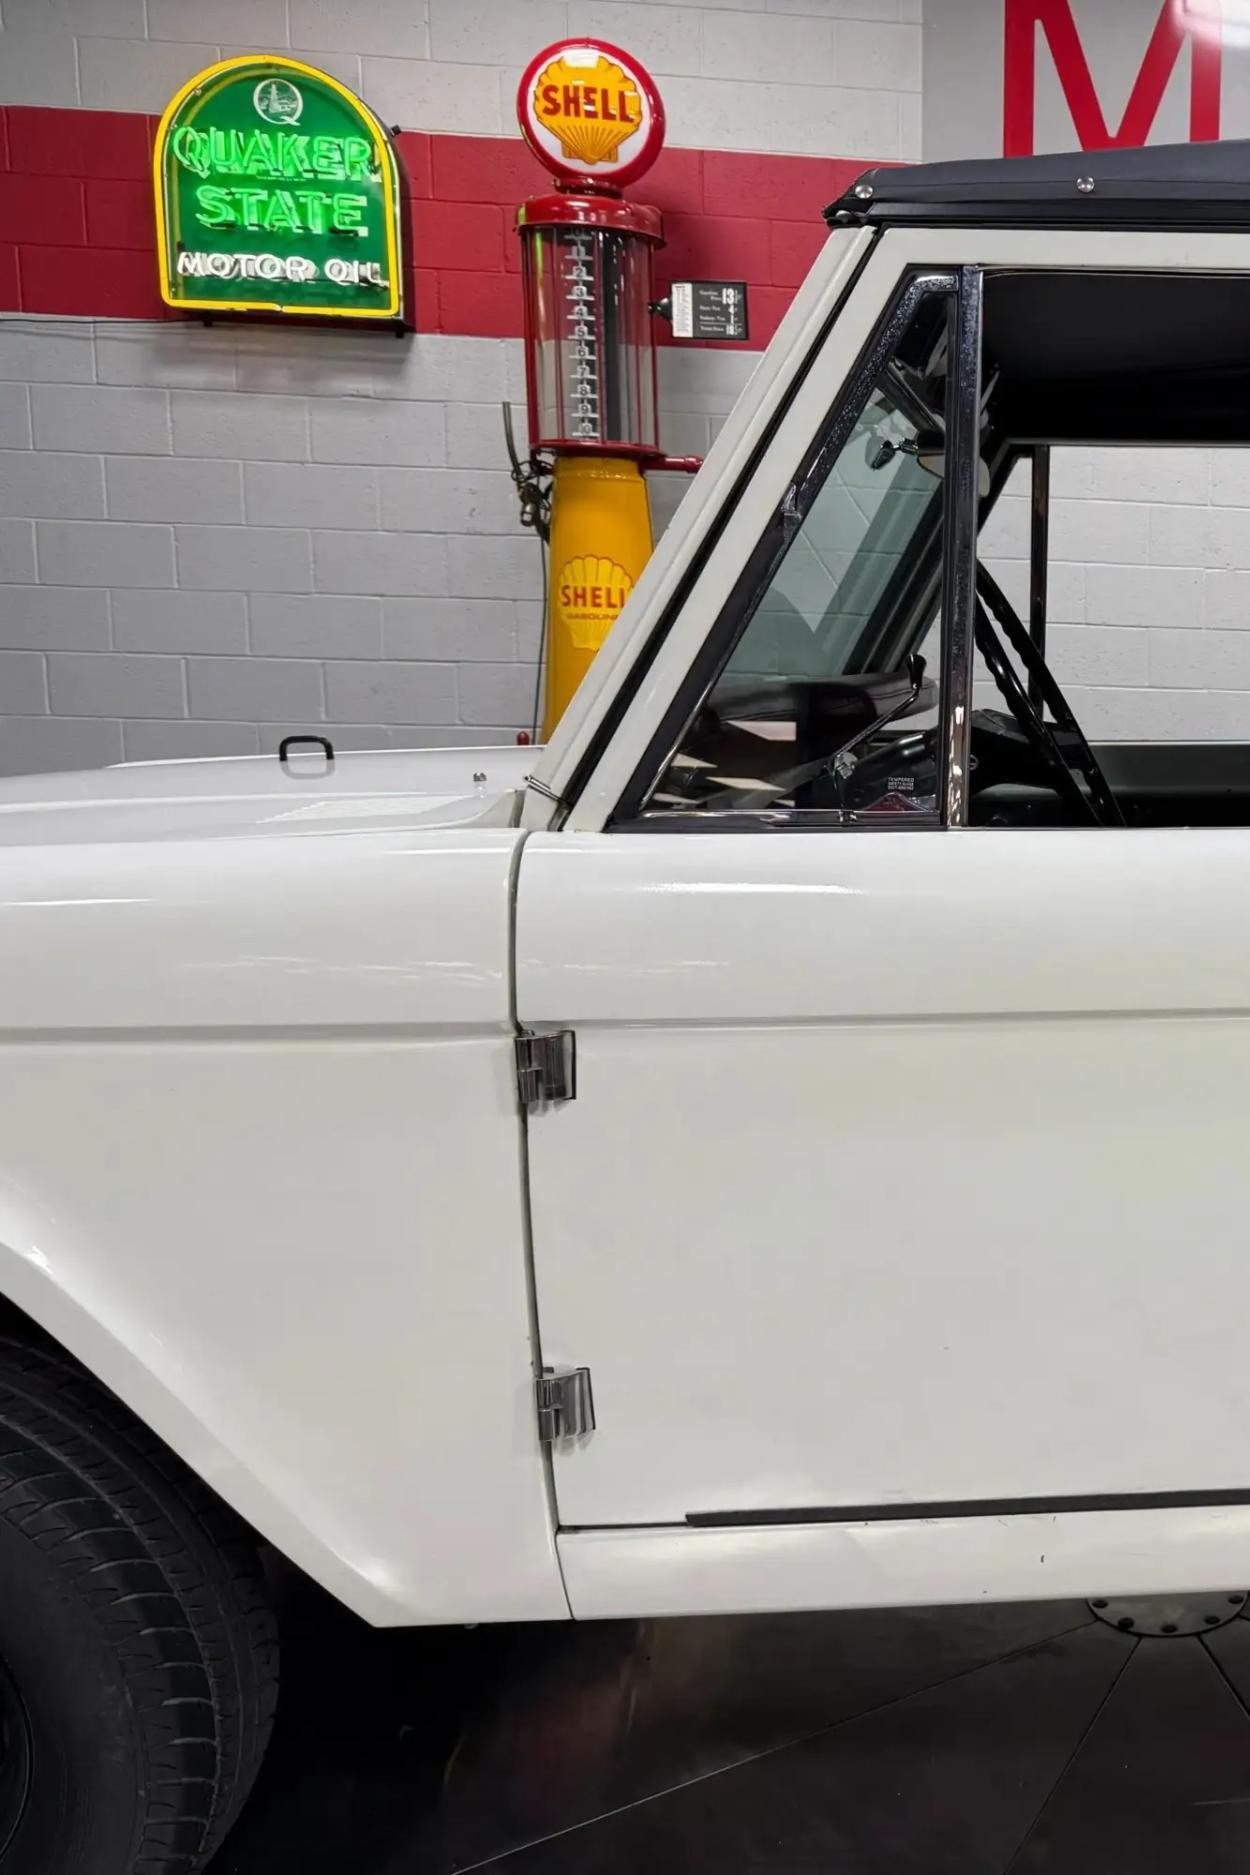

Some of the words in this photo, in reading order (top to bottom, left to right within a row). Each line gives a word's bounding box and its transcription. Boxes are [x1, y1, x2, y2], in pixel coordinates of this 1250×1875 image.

[542, 84, 635, 123] SHELL
[173, 126, 382, 183] QUAKER
[195, 185, 369, 237] STATE
[177, 252, 319, 281] MOTOR
[324, 258, 390, 287] OIL
